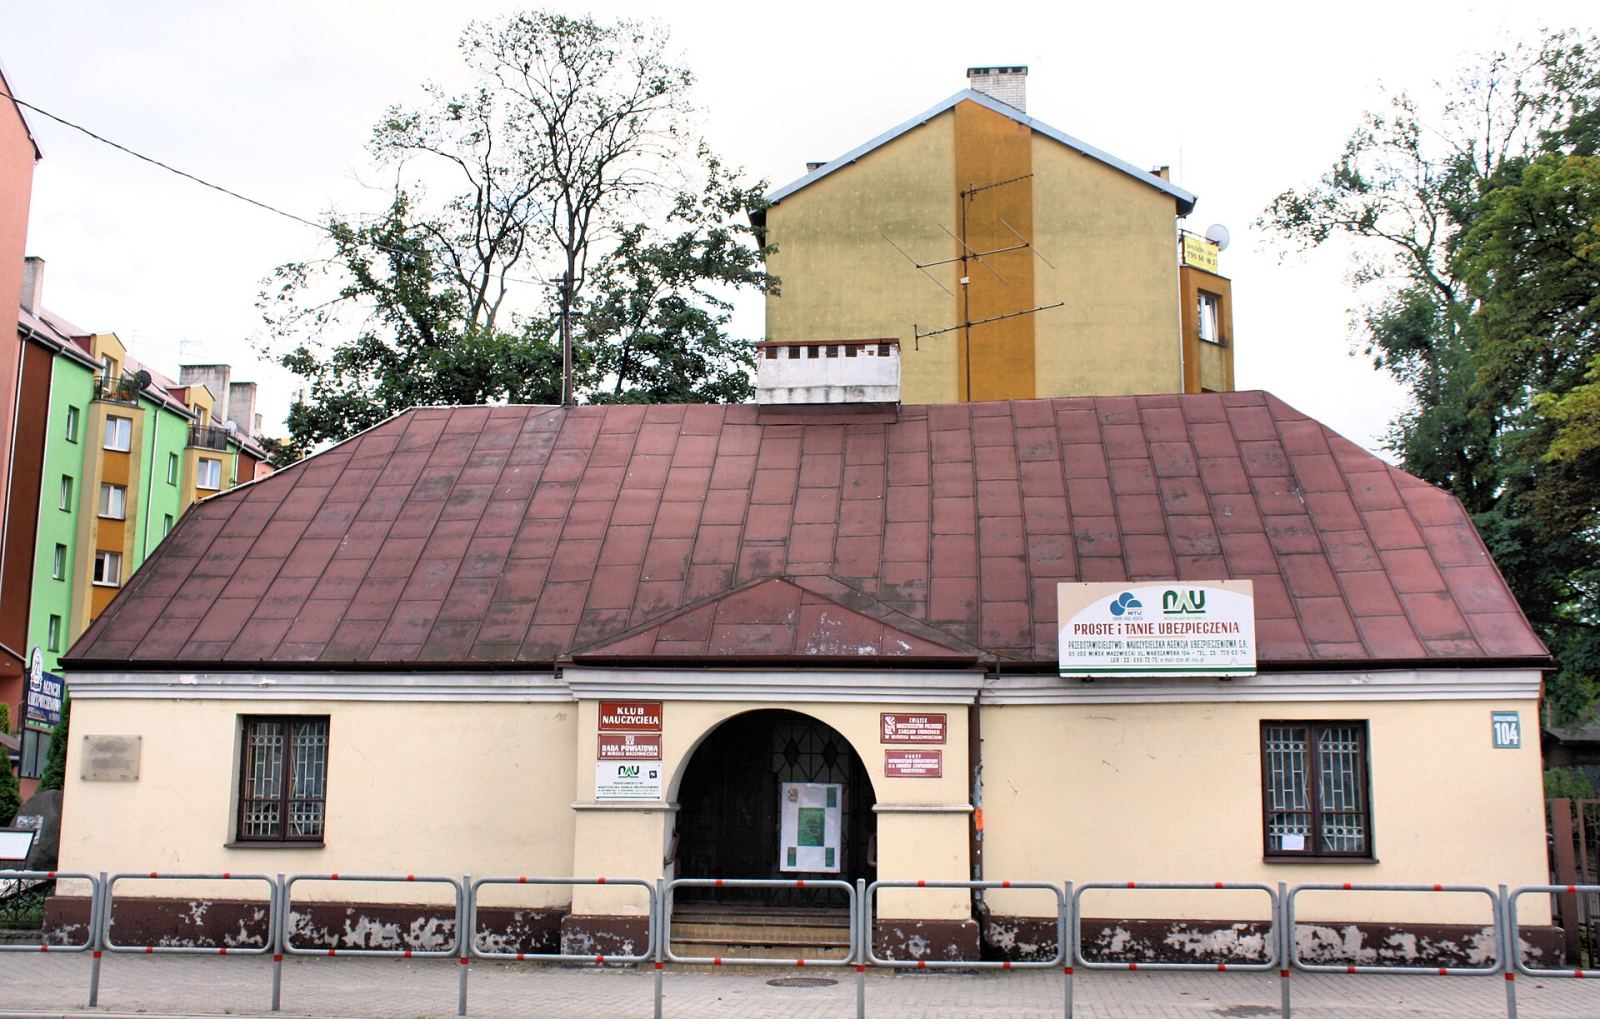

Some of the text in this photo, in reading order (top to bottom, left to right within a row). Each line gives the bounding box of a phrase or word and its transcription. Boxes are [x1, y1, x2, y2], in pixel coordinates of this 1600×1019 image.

[1074, 622, 1240, 636] PROSTE i TANIE UBEZPIECZENIA
[1166, 639, 1188, 649] AGENCJA
[617, 707, 645, 715] KLUB
[602, 715, 660, 724] NAUCZYCIELA
[1494, 722, 1519, 745] 104
[601, 744, 659, 752] RADA POWIATOWA
